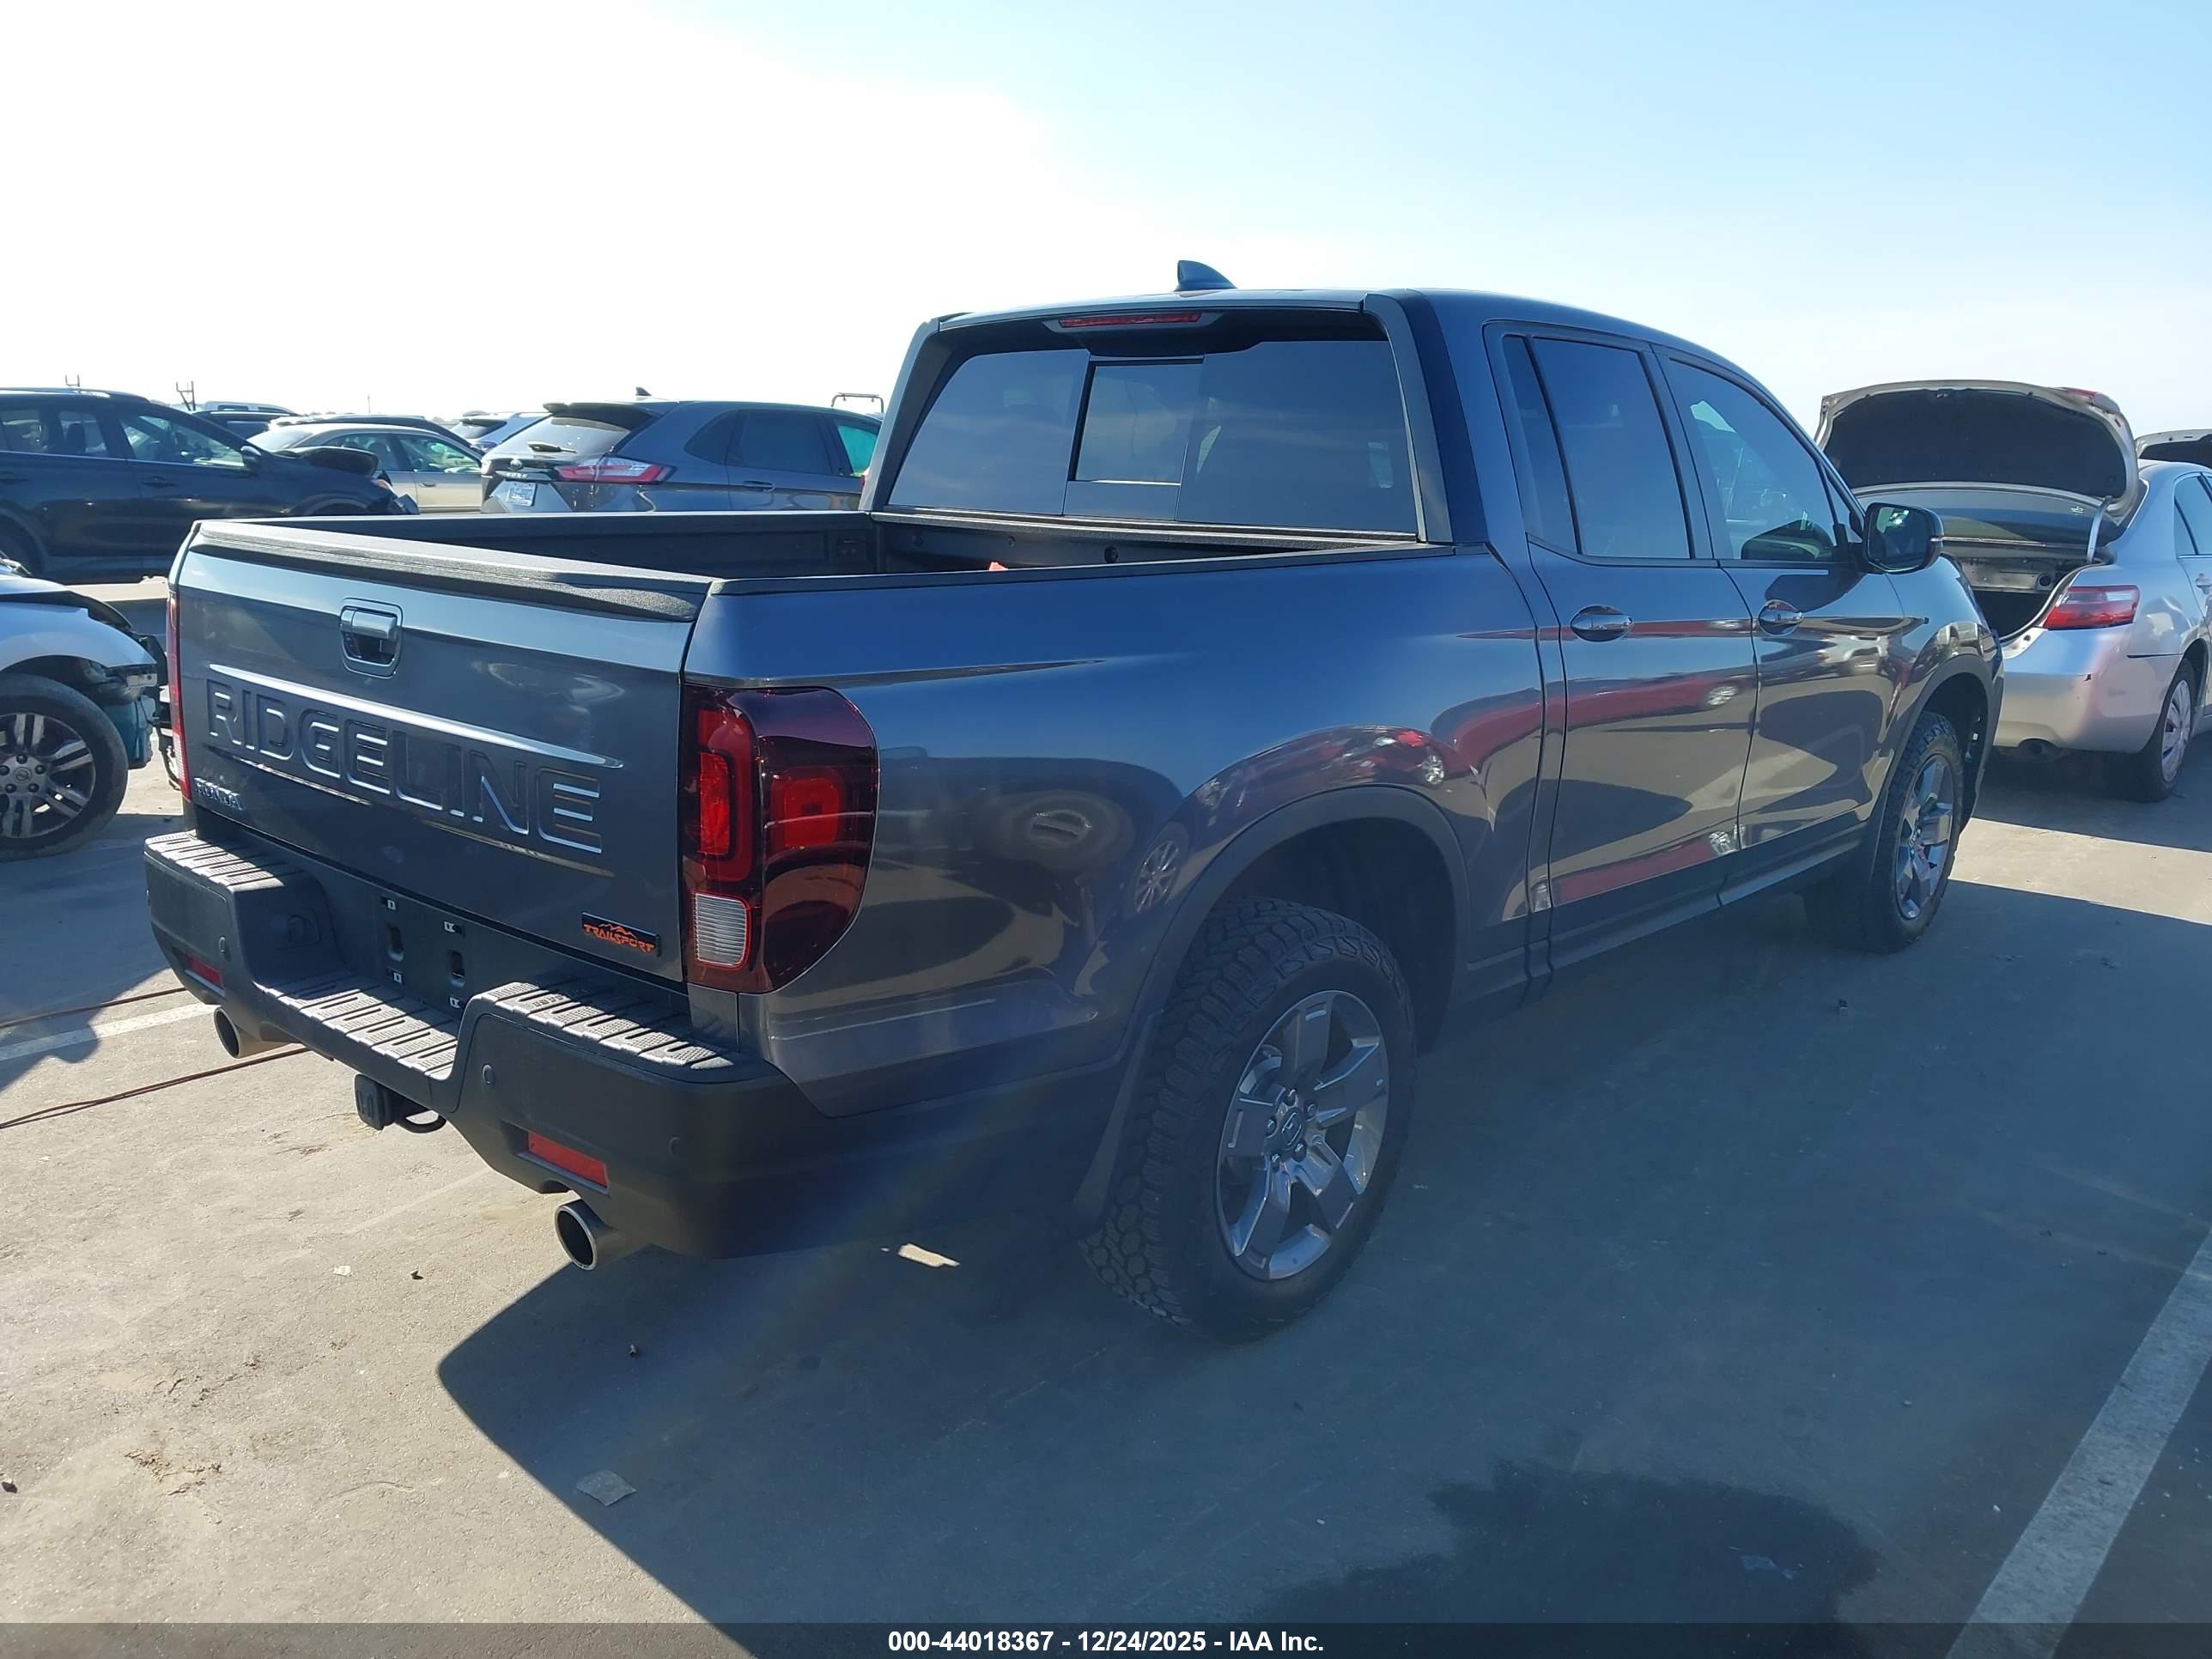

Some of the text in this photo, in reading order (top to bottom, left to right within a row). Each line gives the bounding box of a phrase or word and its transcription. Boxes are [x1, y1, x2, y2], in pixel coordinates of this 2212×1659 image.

[206, 678, 602, 854] RIDGELINE
[193, 777, 243, 811] HONDA
[583, 923, 655, 953] TRAILSPORT
